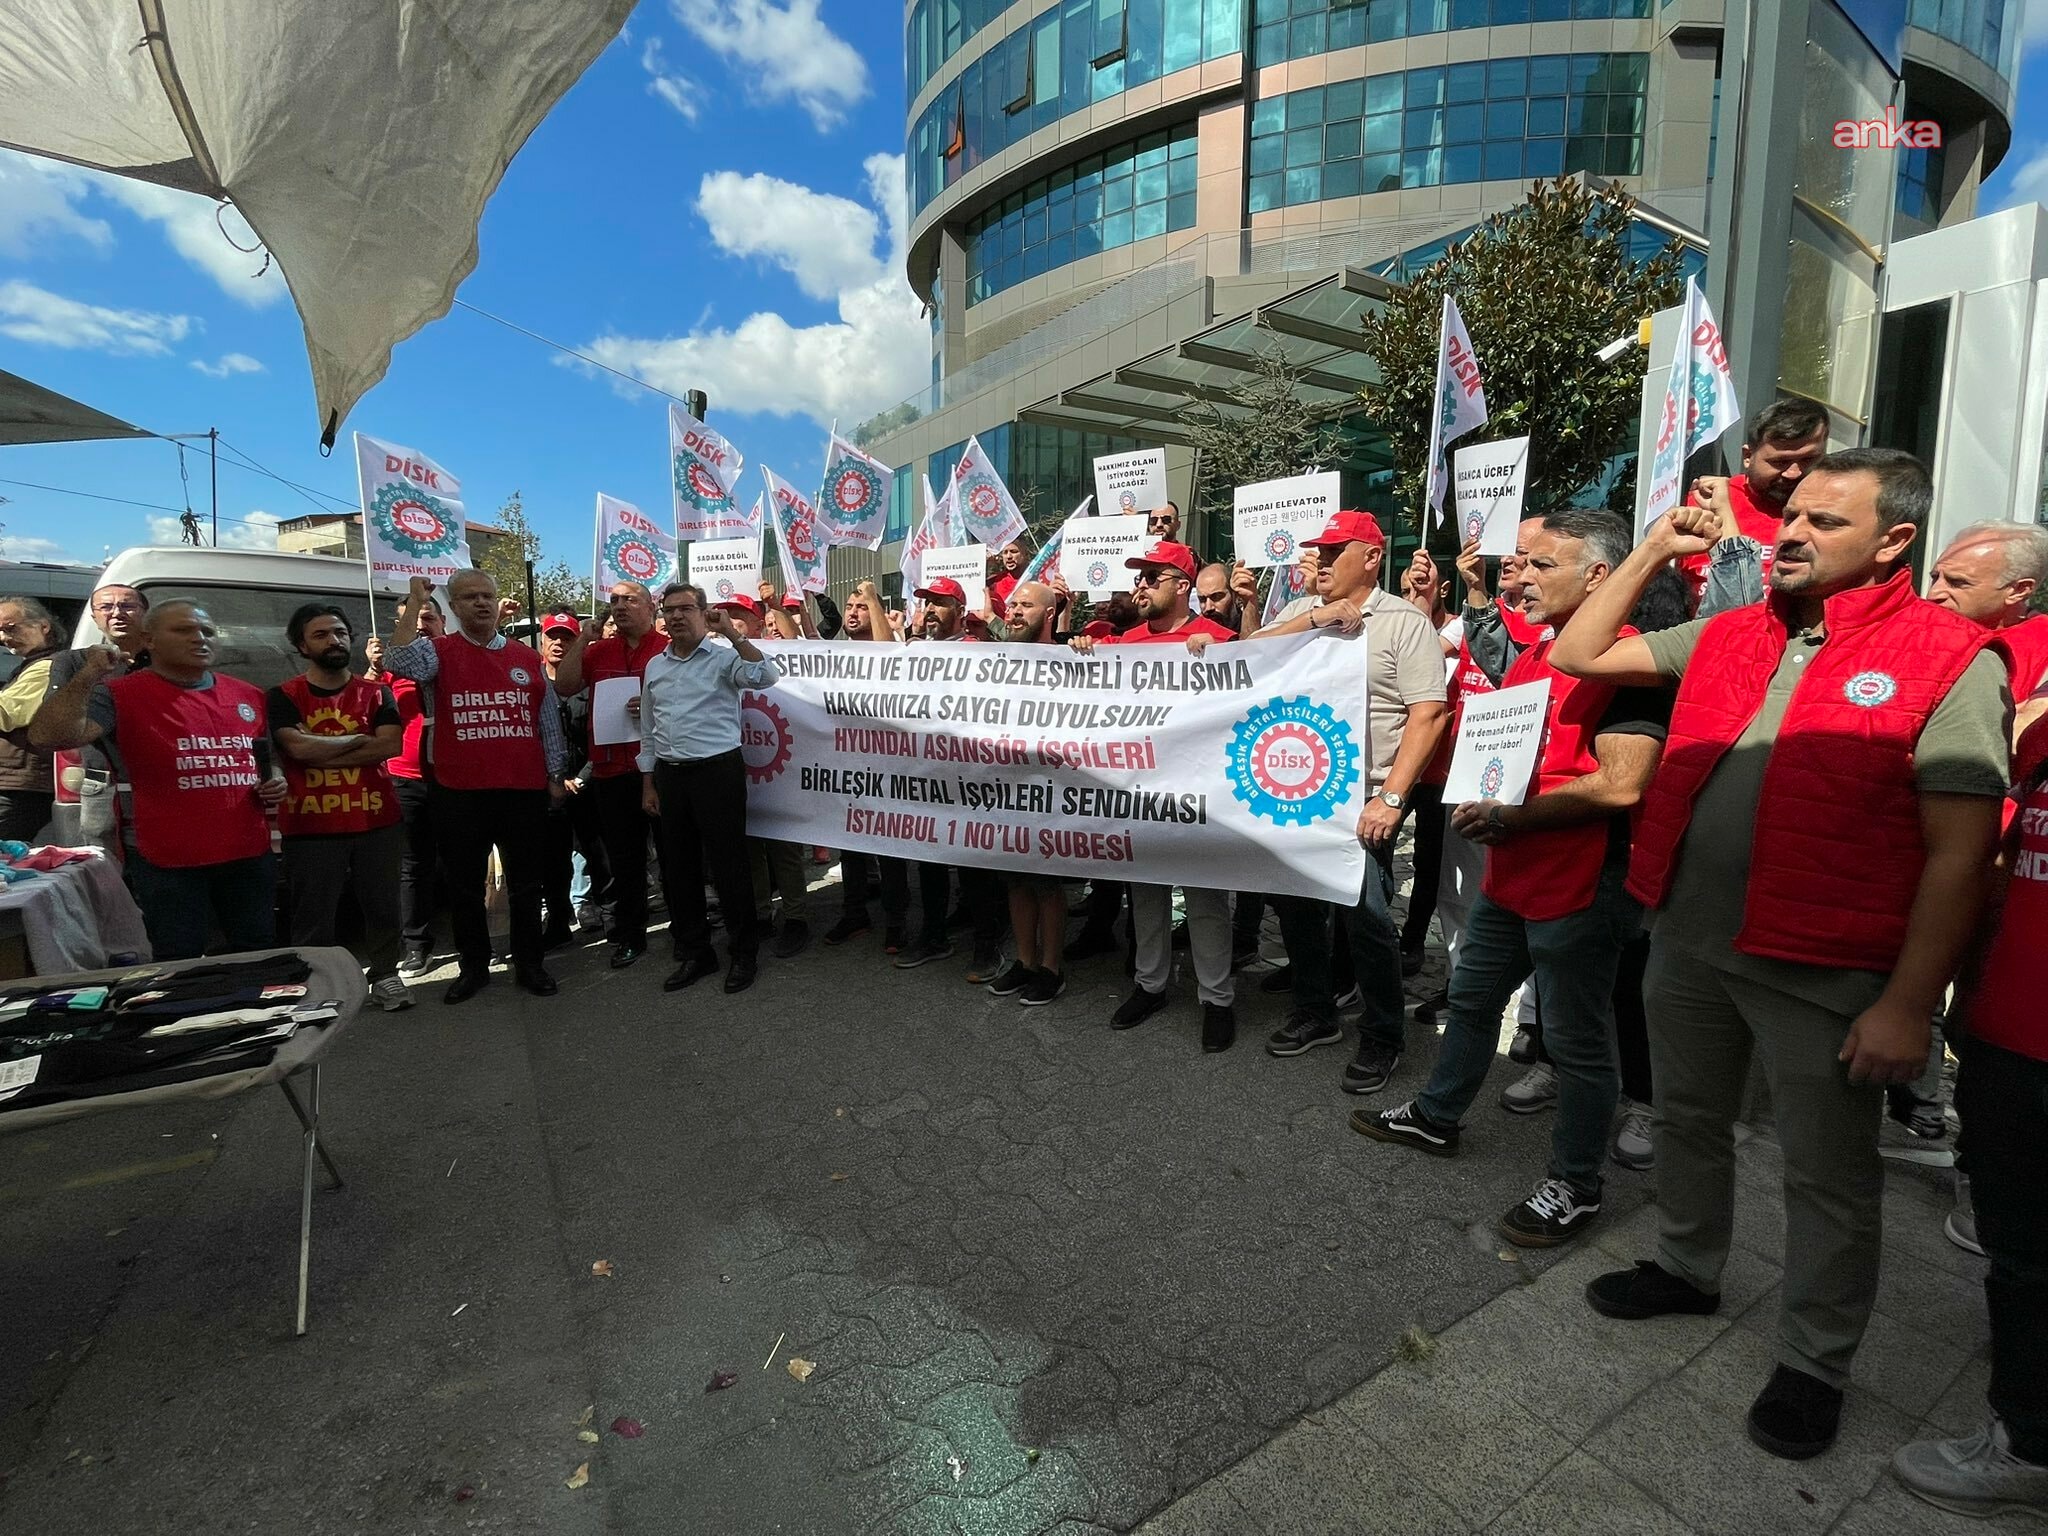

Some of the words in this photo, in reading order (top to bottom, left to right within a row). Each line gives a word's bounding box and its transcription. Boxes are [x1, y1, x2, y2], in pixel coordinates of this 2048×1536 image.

[683, 430, 727, 468] DİSK
[385, 454, 439, 489] DİSK
[1132, 458, 1157, 467] OLANI
[1484, 464, 1516, 478] ÜCRET
[1480, 485, 1516, 501] YAŞAM!
[1238, 503, 1273, 515] HYUNDAI
[1275, 496, 1327, 509] ELEVATOR
[402, 512, 434, 527] DİSK
[1099, 535, 1139, 545] YAŞAMAK
[775, 650, 874, 680] SENDİKALI
[880, 656, 901, 681] VE
[908, 655, 972, 682] TOPLU
[976, 653, 1121, 690] SÖZLEŞMELİ
[1131, 660, 1254, 695] ÇALIŞMA
[451, 688, 531, 708] BİRLEŞİK
[453, 709, 510, 725] METAL
[823, 691, 931, 719] HAKKIMIZA
[937, 694, 1011, 725] SAYGI
[1017, 699, 1173, 729] DUYULSUN!
[1466, 710, 1499, 724] HYUNDAI
[1500, 702, 1538, 719] ELEVATOR
[456, 723, 533, 741] SENDİKASI
[1243, 710, 1278, 741] METAL
[1282, 706, 1334, 733] İŞÇİLERİ
[1465, 729, 1475, 739] We
[1477, 726, 1505, 738] demand
[1506, 723, 1520, 734] fair
[1521, 722, 1535, 736] pay
[176, 734, 254, 751] BİRLEŞİK
[834, 728, 917, 758] HYUNDAI
[923, 733, 1029, 765] ASANSÖR
[1037, 735, 1156, 770] İŞÇİLERİ
[1474, 742, 1486, 752] for
[1487, 743, 1500, 751] our
[1500, 738, 1523, 750] labor!
[176, 755, 240, 771] METAL
[1268, 749, 1311, 769] DİSK
[1323, 733, 1347, 801] SENDİKASI
[177, 771, 258, 790] SENDİKAS
[305, 767, 361, 788] DEV
[1237, 743, 1259, 799] BİRLEŞİK
[801, 763, 884, 799] BİRLEŞİK
[890, 774, 955, 805] METAL
[958, 775, 1053, 813] İŞÇİLERİ
[1062, 784, 1207, 825] SENDİKASI
[1276, 803, 1302, 814] 1947
[845, 803, 938, 843] İSTANBUL
[947, 820, 957, 846] 1
[964, 821, 1030, 854] NO'LU
[1038, 829, 1134, 862] ŞUBESİ
